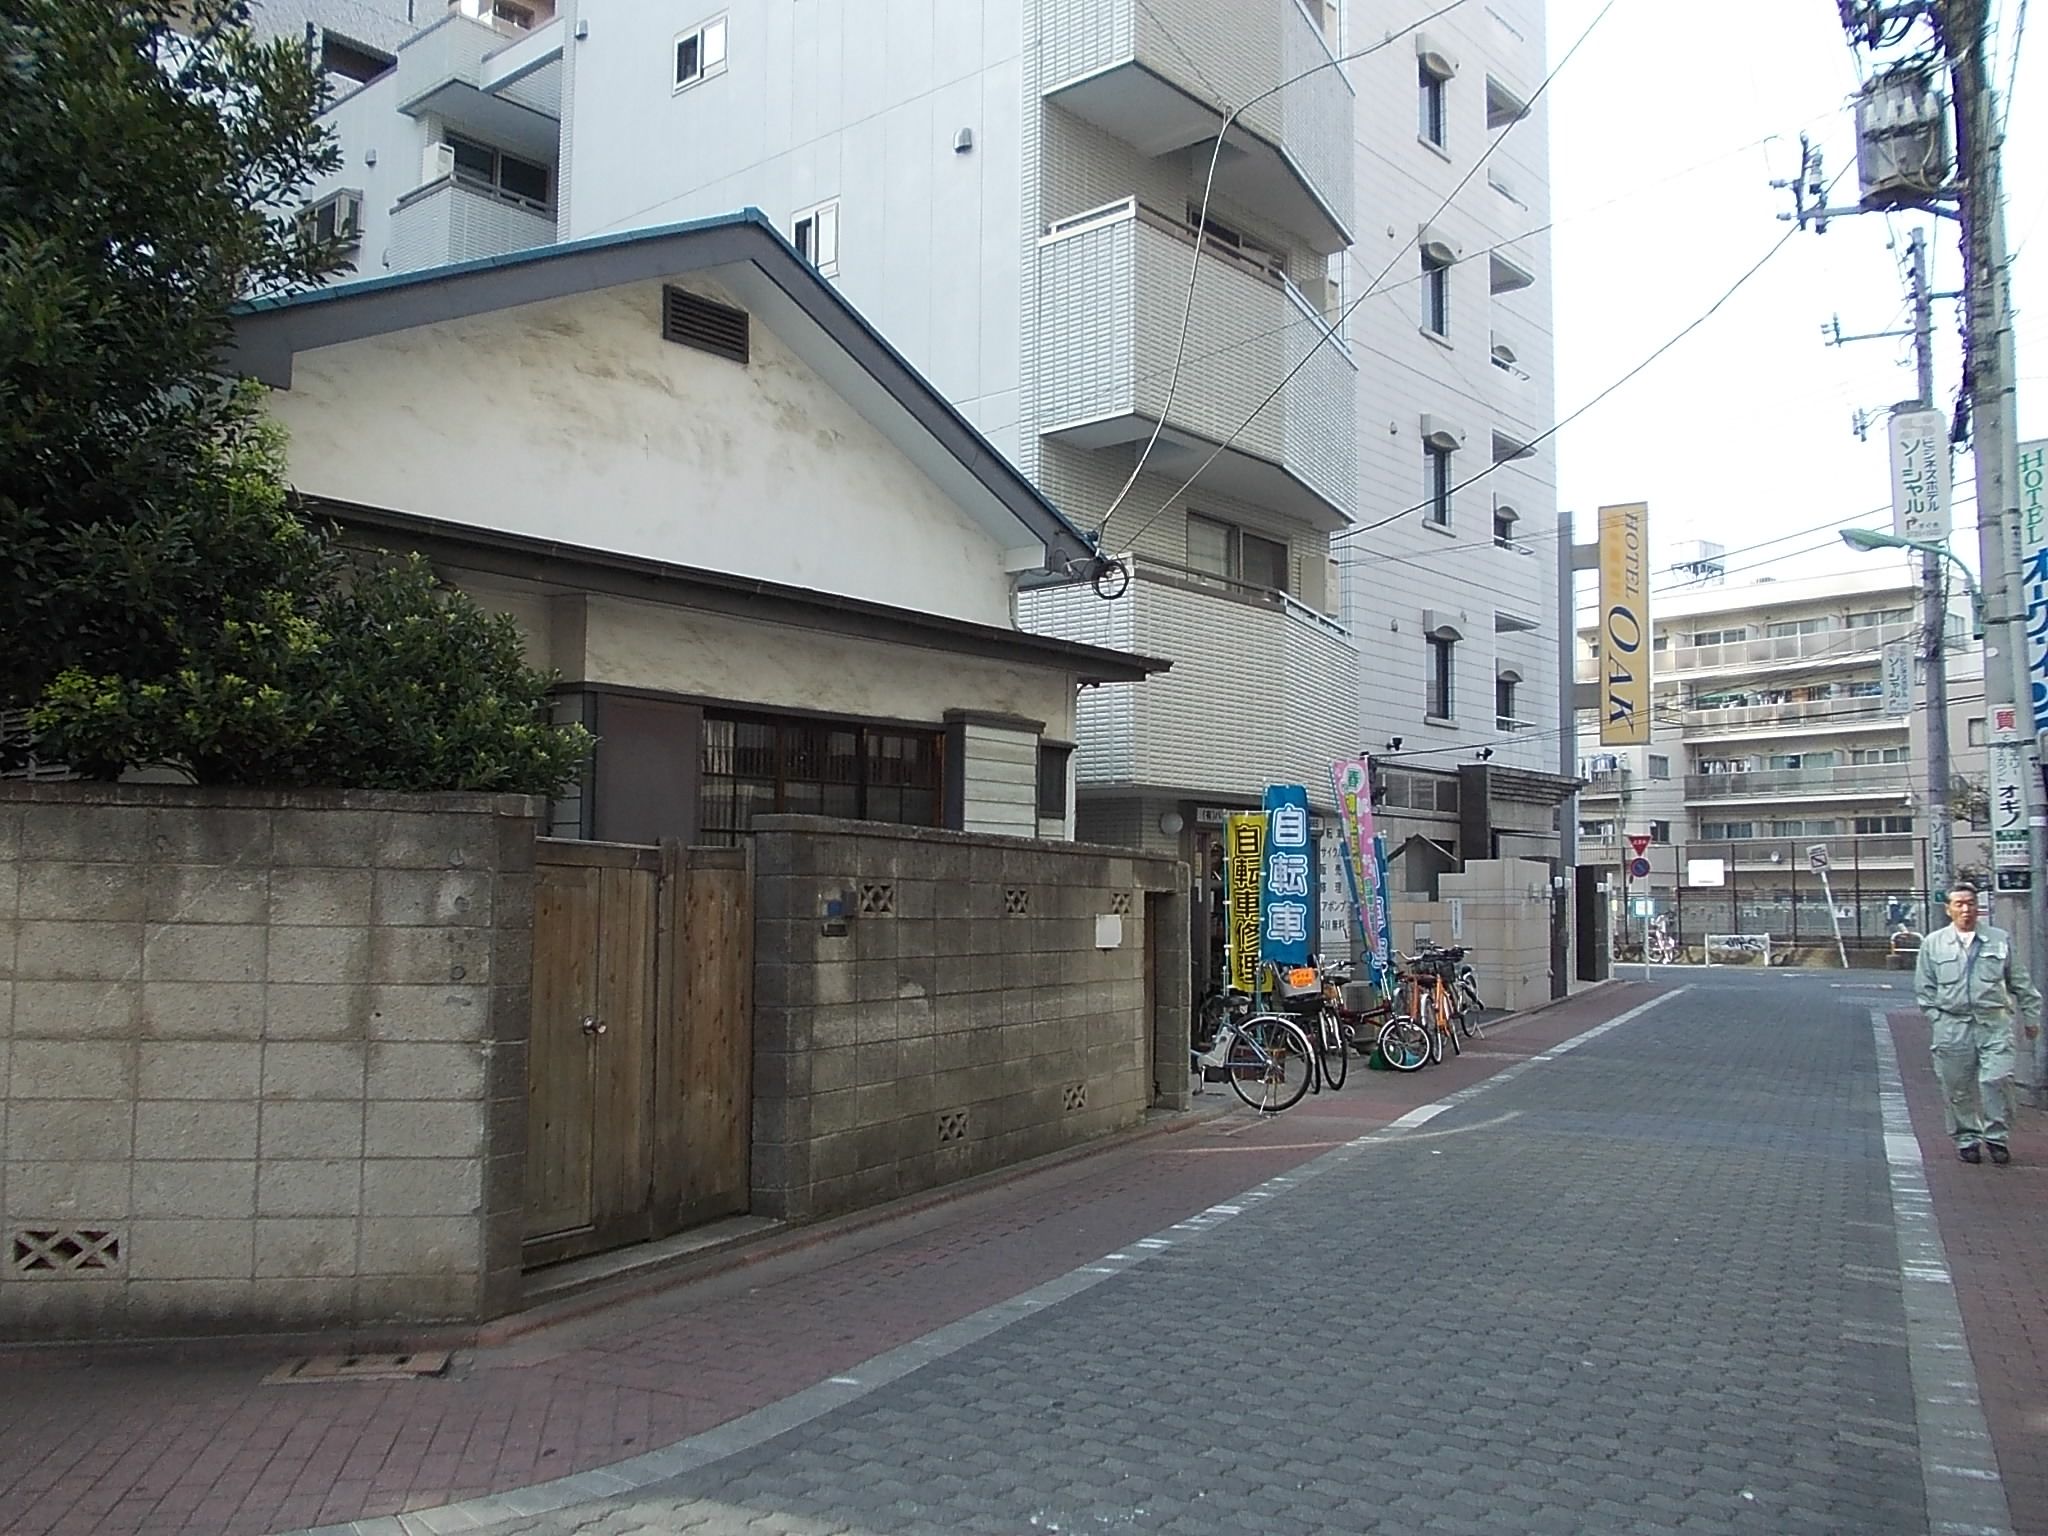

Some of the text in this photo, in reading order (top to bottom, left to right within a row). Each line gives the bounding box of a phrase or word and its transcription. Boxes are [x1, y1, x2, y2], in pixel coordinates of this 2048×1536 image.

[1900, 439, 1925, 515] ソーシャル
[2021, 447, 2044, 545] HOTEL
[1625, 511, 1640, 600] HOTEL
[1607, 604, 1641, 736] OAK
[1996, 710, 2016, 730] 質
[1998, 784, 2020, 828] オギノ
[1234, 825, 1265, 985] 自転車修理
[1267, 803, 1308, 945] 自転車
